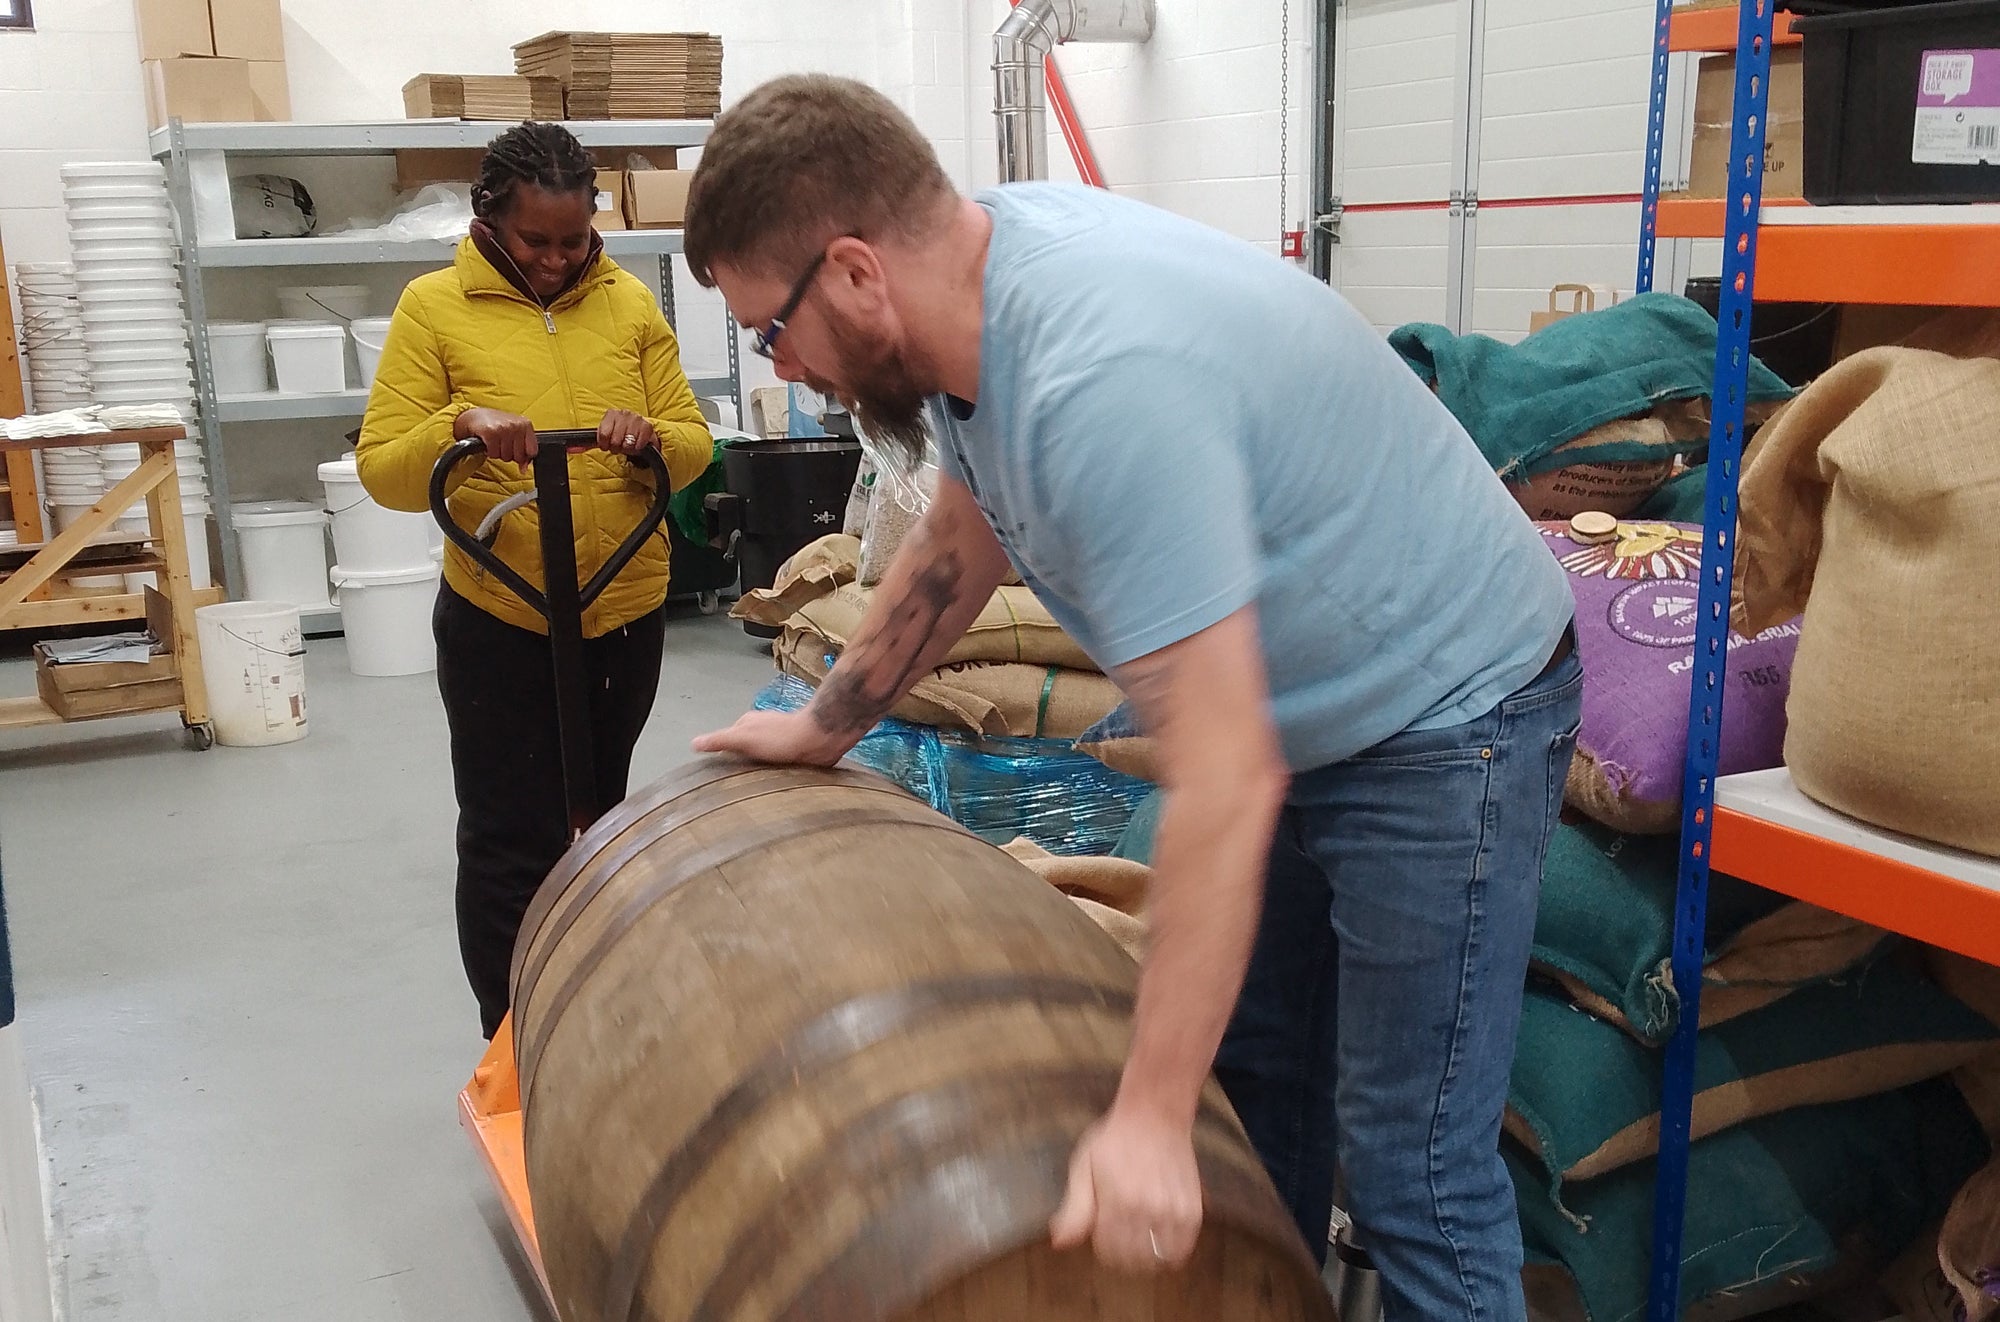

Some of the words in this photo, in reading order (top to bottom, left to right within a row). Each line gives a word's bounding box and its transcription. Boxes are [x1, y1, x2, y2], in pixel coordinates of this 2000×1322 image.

[1927, 69, 1962, 80] STORAGE
[1925, 80, 1941, 91] BOX
[1772, 162, 1785, 172] UP
[1552, 483, 1565, 492] as
